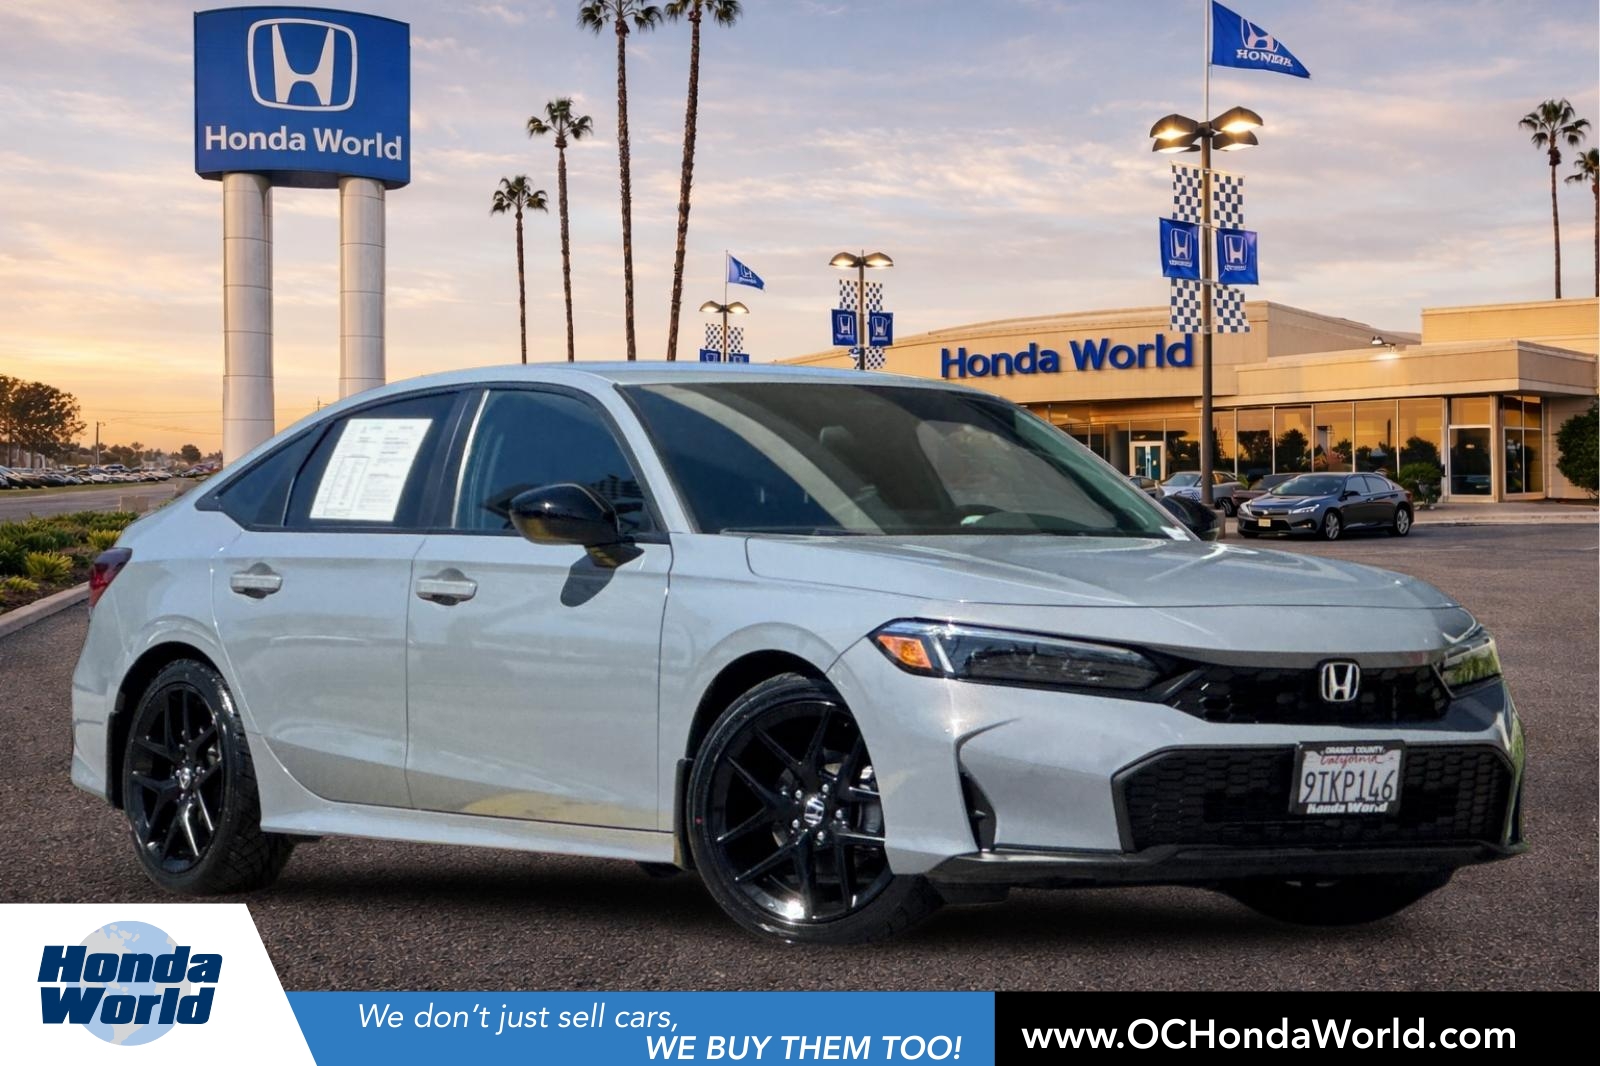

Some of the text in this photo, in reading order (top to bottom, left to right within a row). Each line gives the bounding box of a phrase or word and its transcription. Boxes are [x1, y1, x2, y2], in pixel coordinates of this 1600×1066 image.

[205, 125, 402, 160] Honda World
[940, 333, 1194, 378] Honda World
[1320, 754, 1384, 768] California
[1355, 745, 1384, 754] COUNTY
[1303, 769, 1396, 803] 9TKP146
[1306, 802, 1389, 814] Honda World
